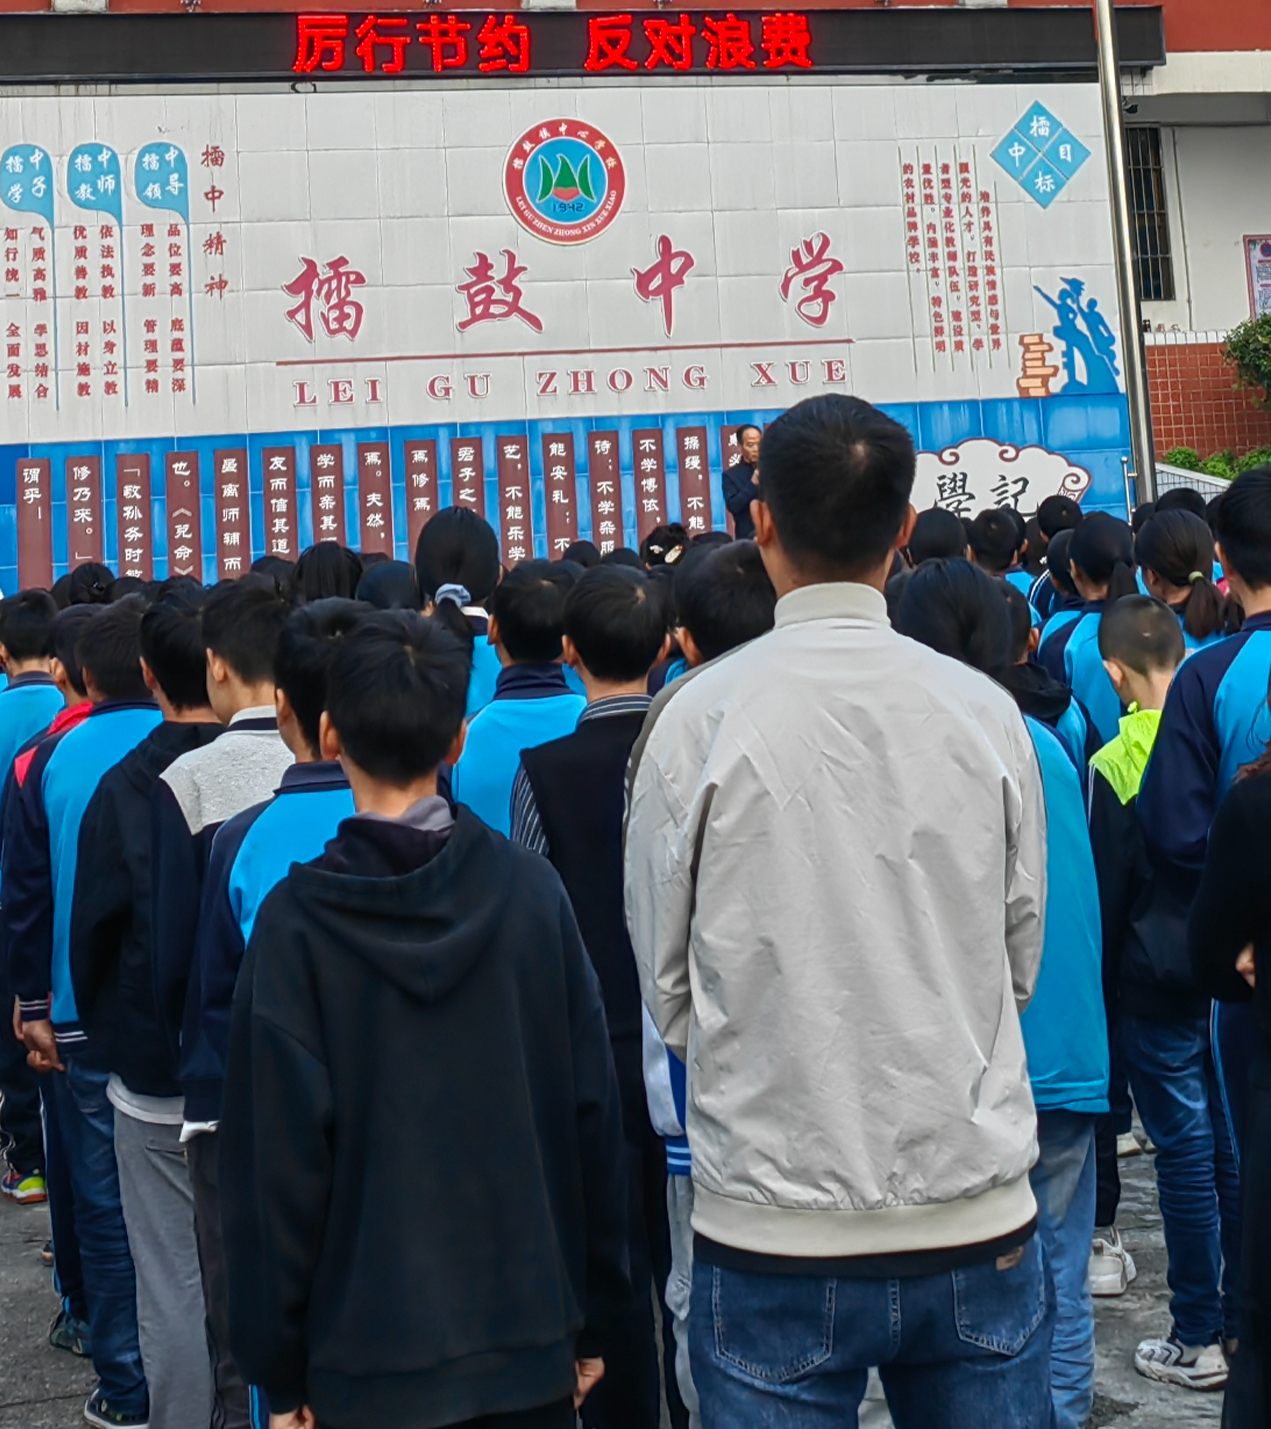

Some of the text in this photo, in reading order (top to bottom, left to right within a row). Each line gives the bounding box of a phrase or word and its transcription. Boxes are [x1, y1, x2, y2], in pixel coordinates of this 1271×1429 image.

[292, 11, 815, 73] 厉行节约 反对浪费
[201, 144, 229, 301] 擂中精神
[283, 231, 846, 343] 擂鼓中学
[552, 203, 584, 212] 1942
[4, 227, 22, 399] 知行统一 全面发展
[30, 226, 49, 399] 气质高雅 学思结合
[73, 225, 91, 397] 优质善教 因材施教
[99, 225, 118, 396] 依法执教 以身立教
[141, 224, 159, 393] 理念要新 管理要精
[167, 224, 186, 393] 品位要高 底蕴要深
[293, 357, 847, 407] LEI GU ZHONG XUE
[317, 453, 338, 542] 学而亲其
